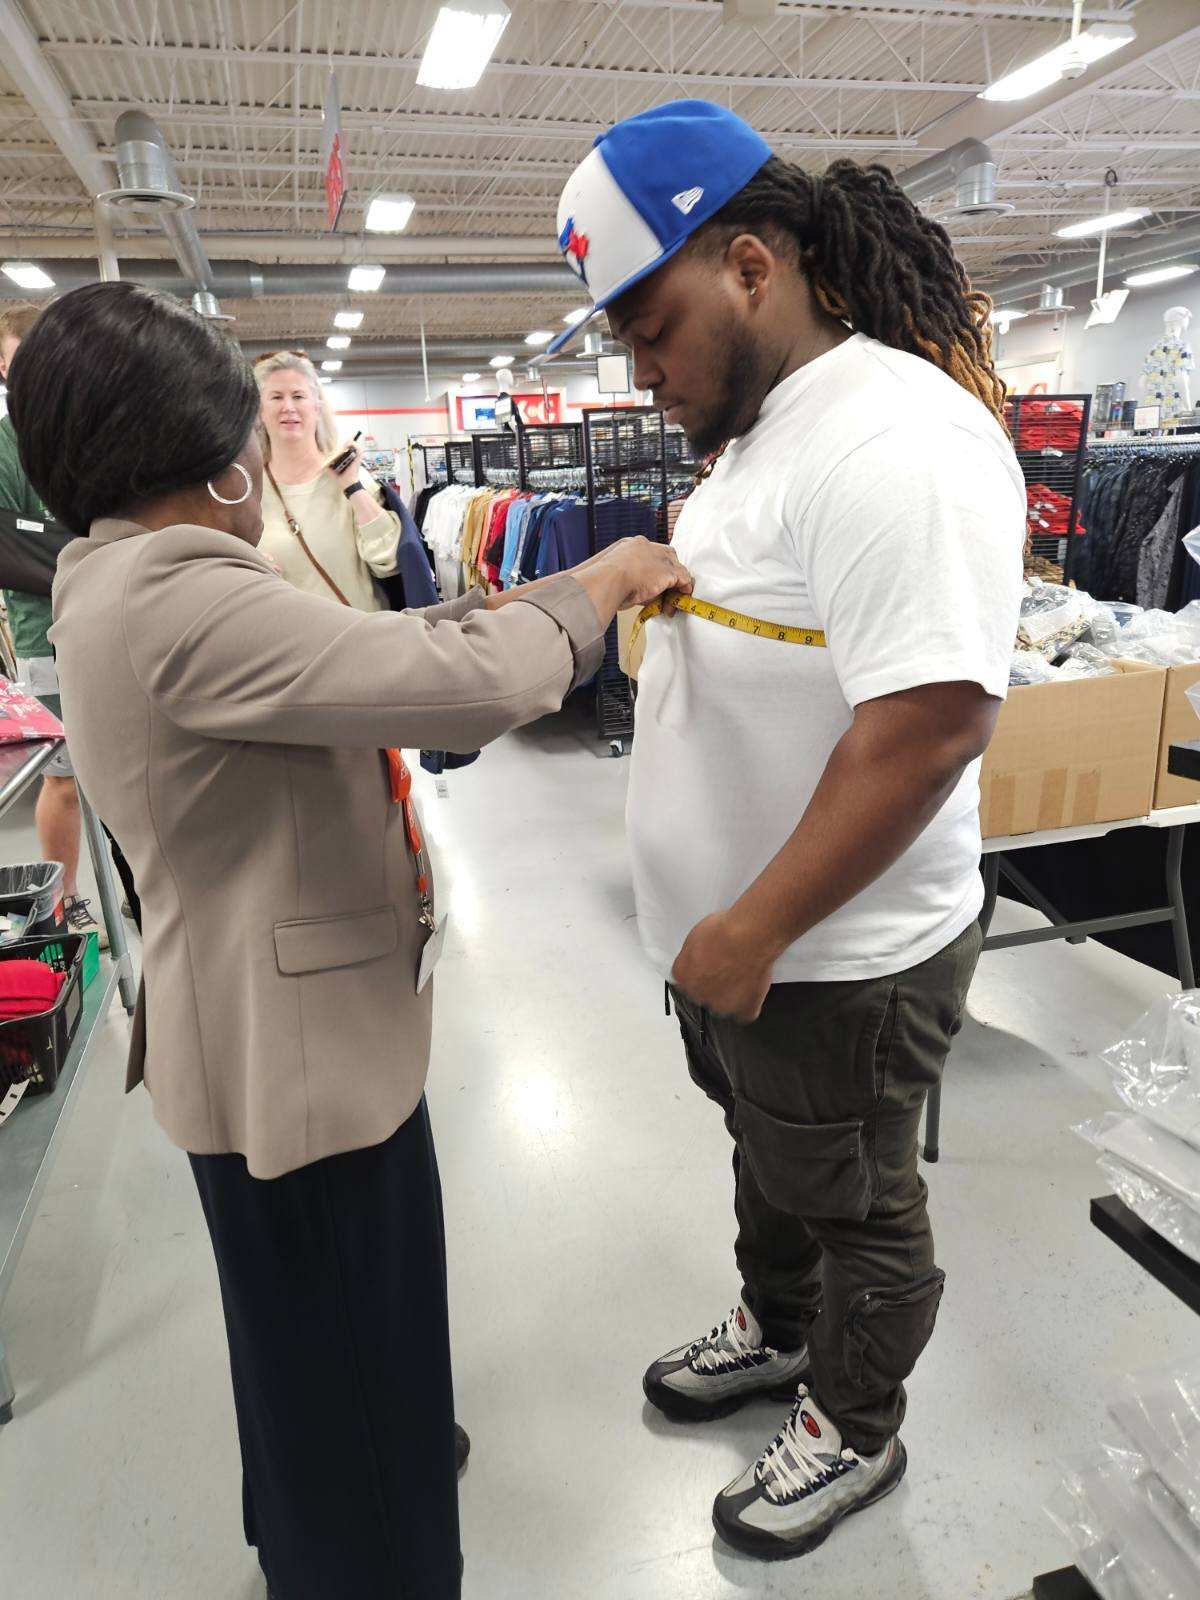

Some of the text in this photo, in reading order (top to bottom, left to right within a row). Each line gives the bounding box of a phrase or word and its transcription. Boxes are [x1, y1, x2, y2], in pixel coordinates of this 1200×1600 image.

[690, 604, 696, 612] 4
[708, 611, 715, 620] 5
[728, 617, 736, 626] 6
[753, 625, 759, 634] 7
[778, 631, 785, 640] 8
[805, 635, 813, 644] 9
